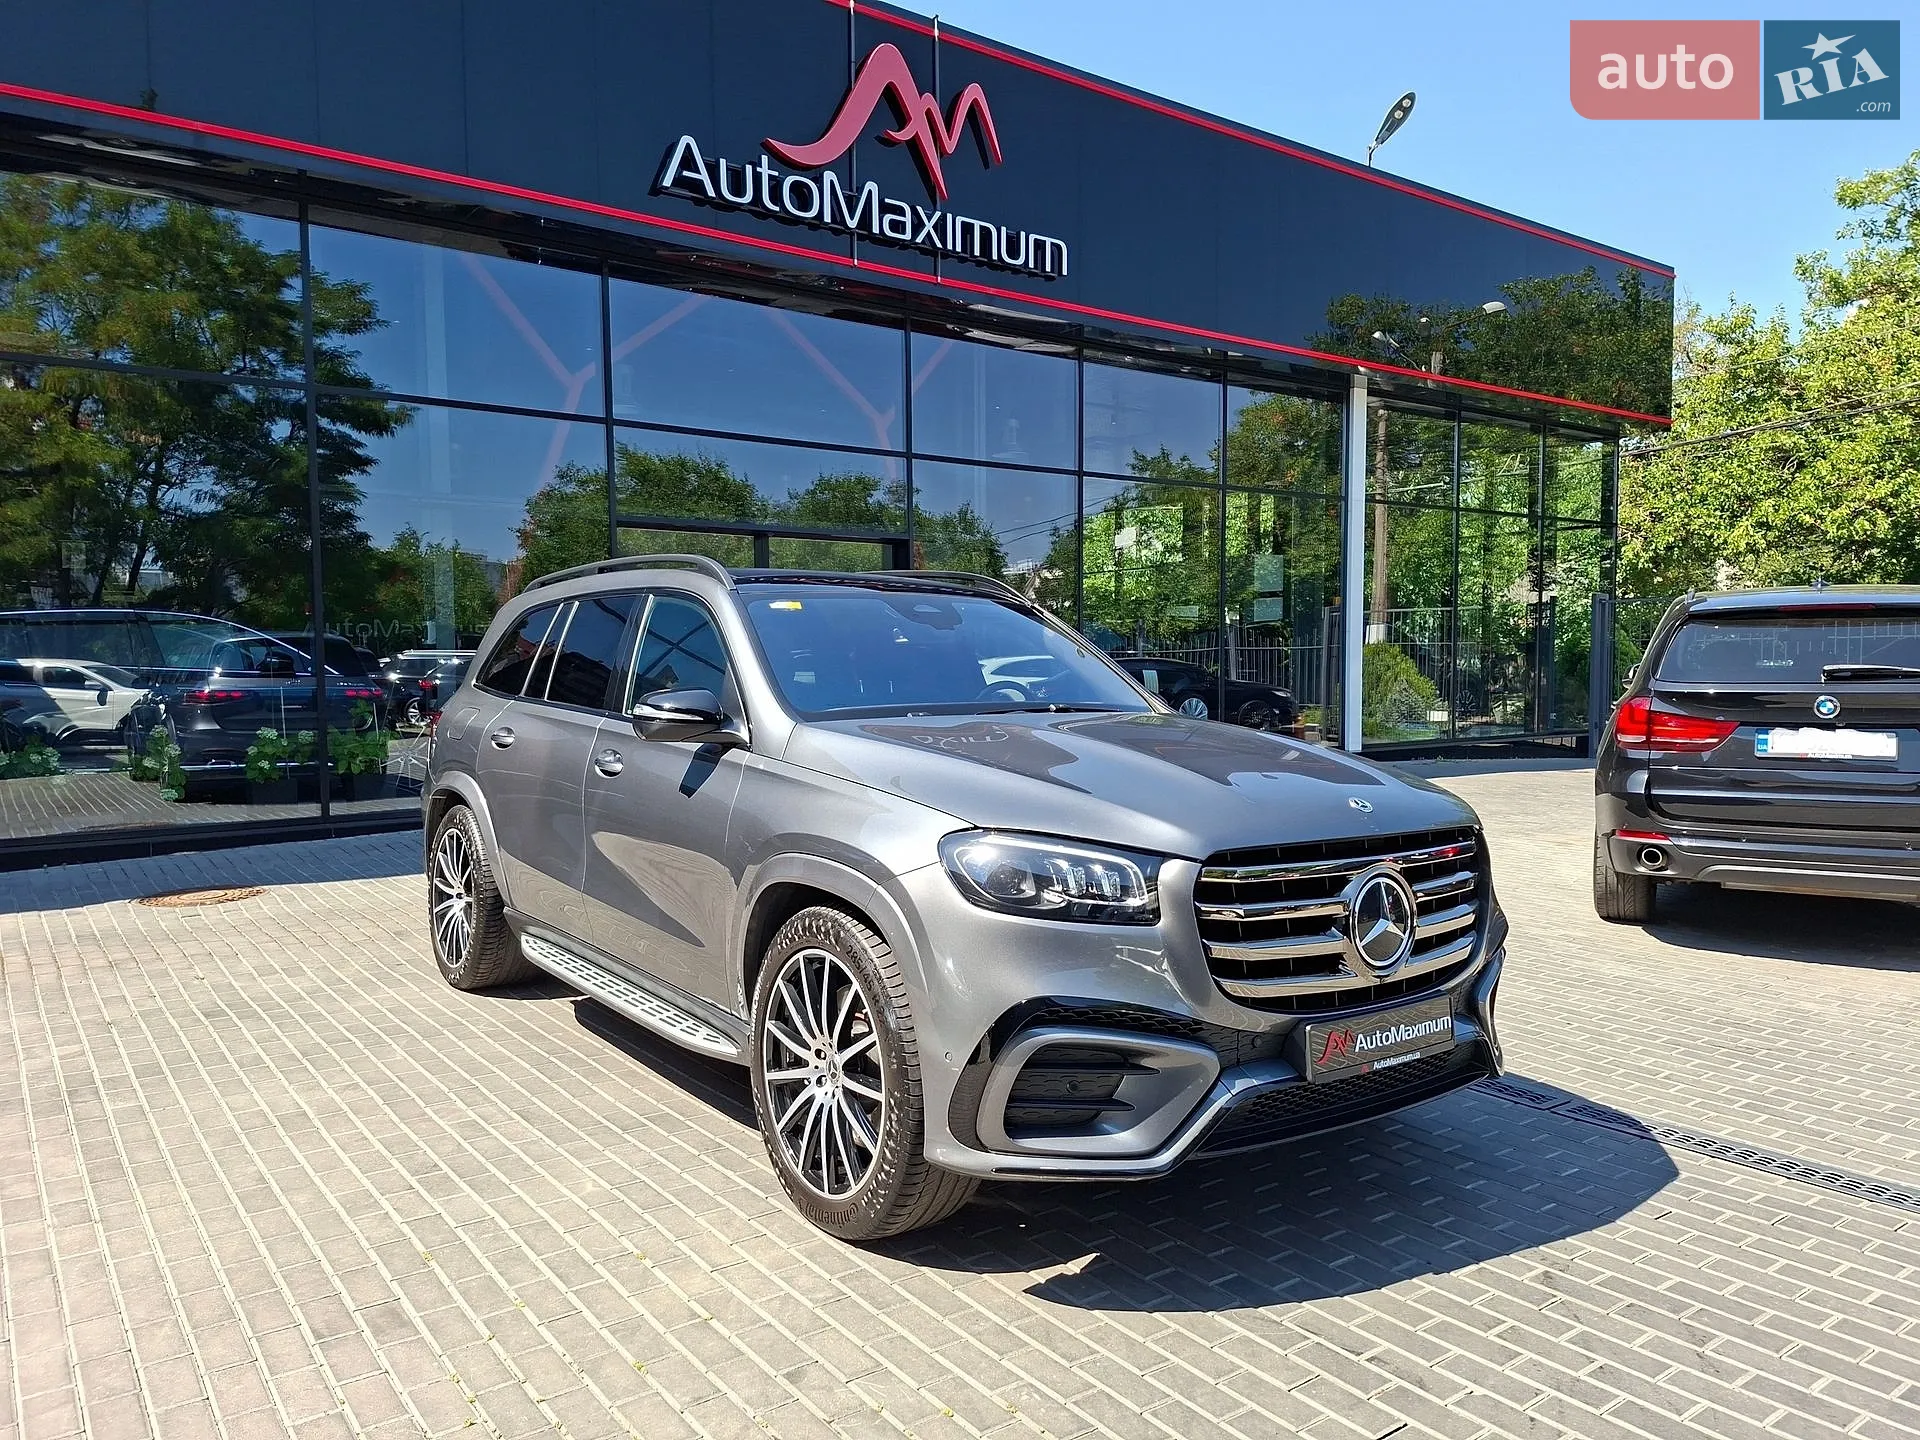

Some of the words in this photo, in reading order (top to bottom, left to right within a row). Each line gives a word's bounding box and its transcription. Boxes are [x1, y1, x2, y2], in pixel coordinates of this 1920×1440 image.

[659, 135, 1069, 277] AutoMaximum
[1354, 1016, 1452, 1053] AutoMaximum
[805, 1202, 859, 1229] Continental
